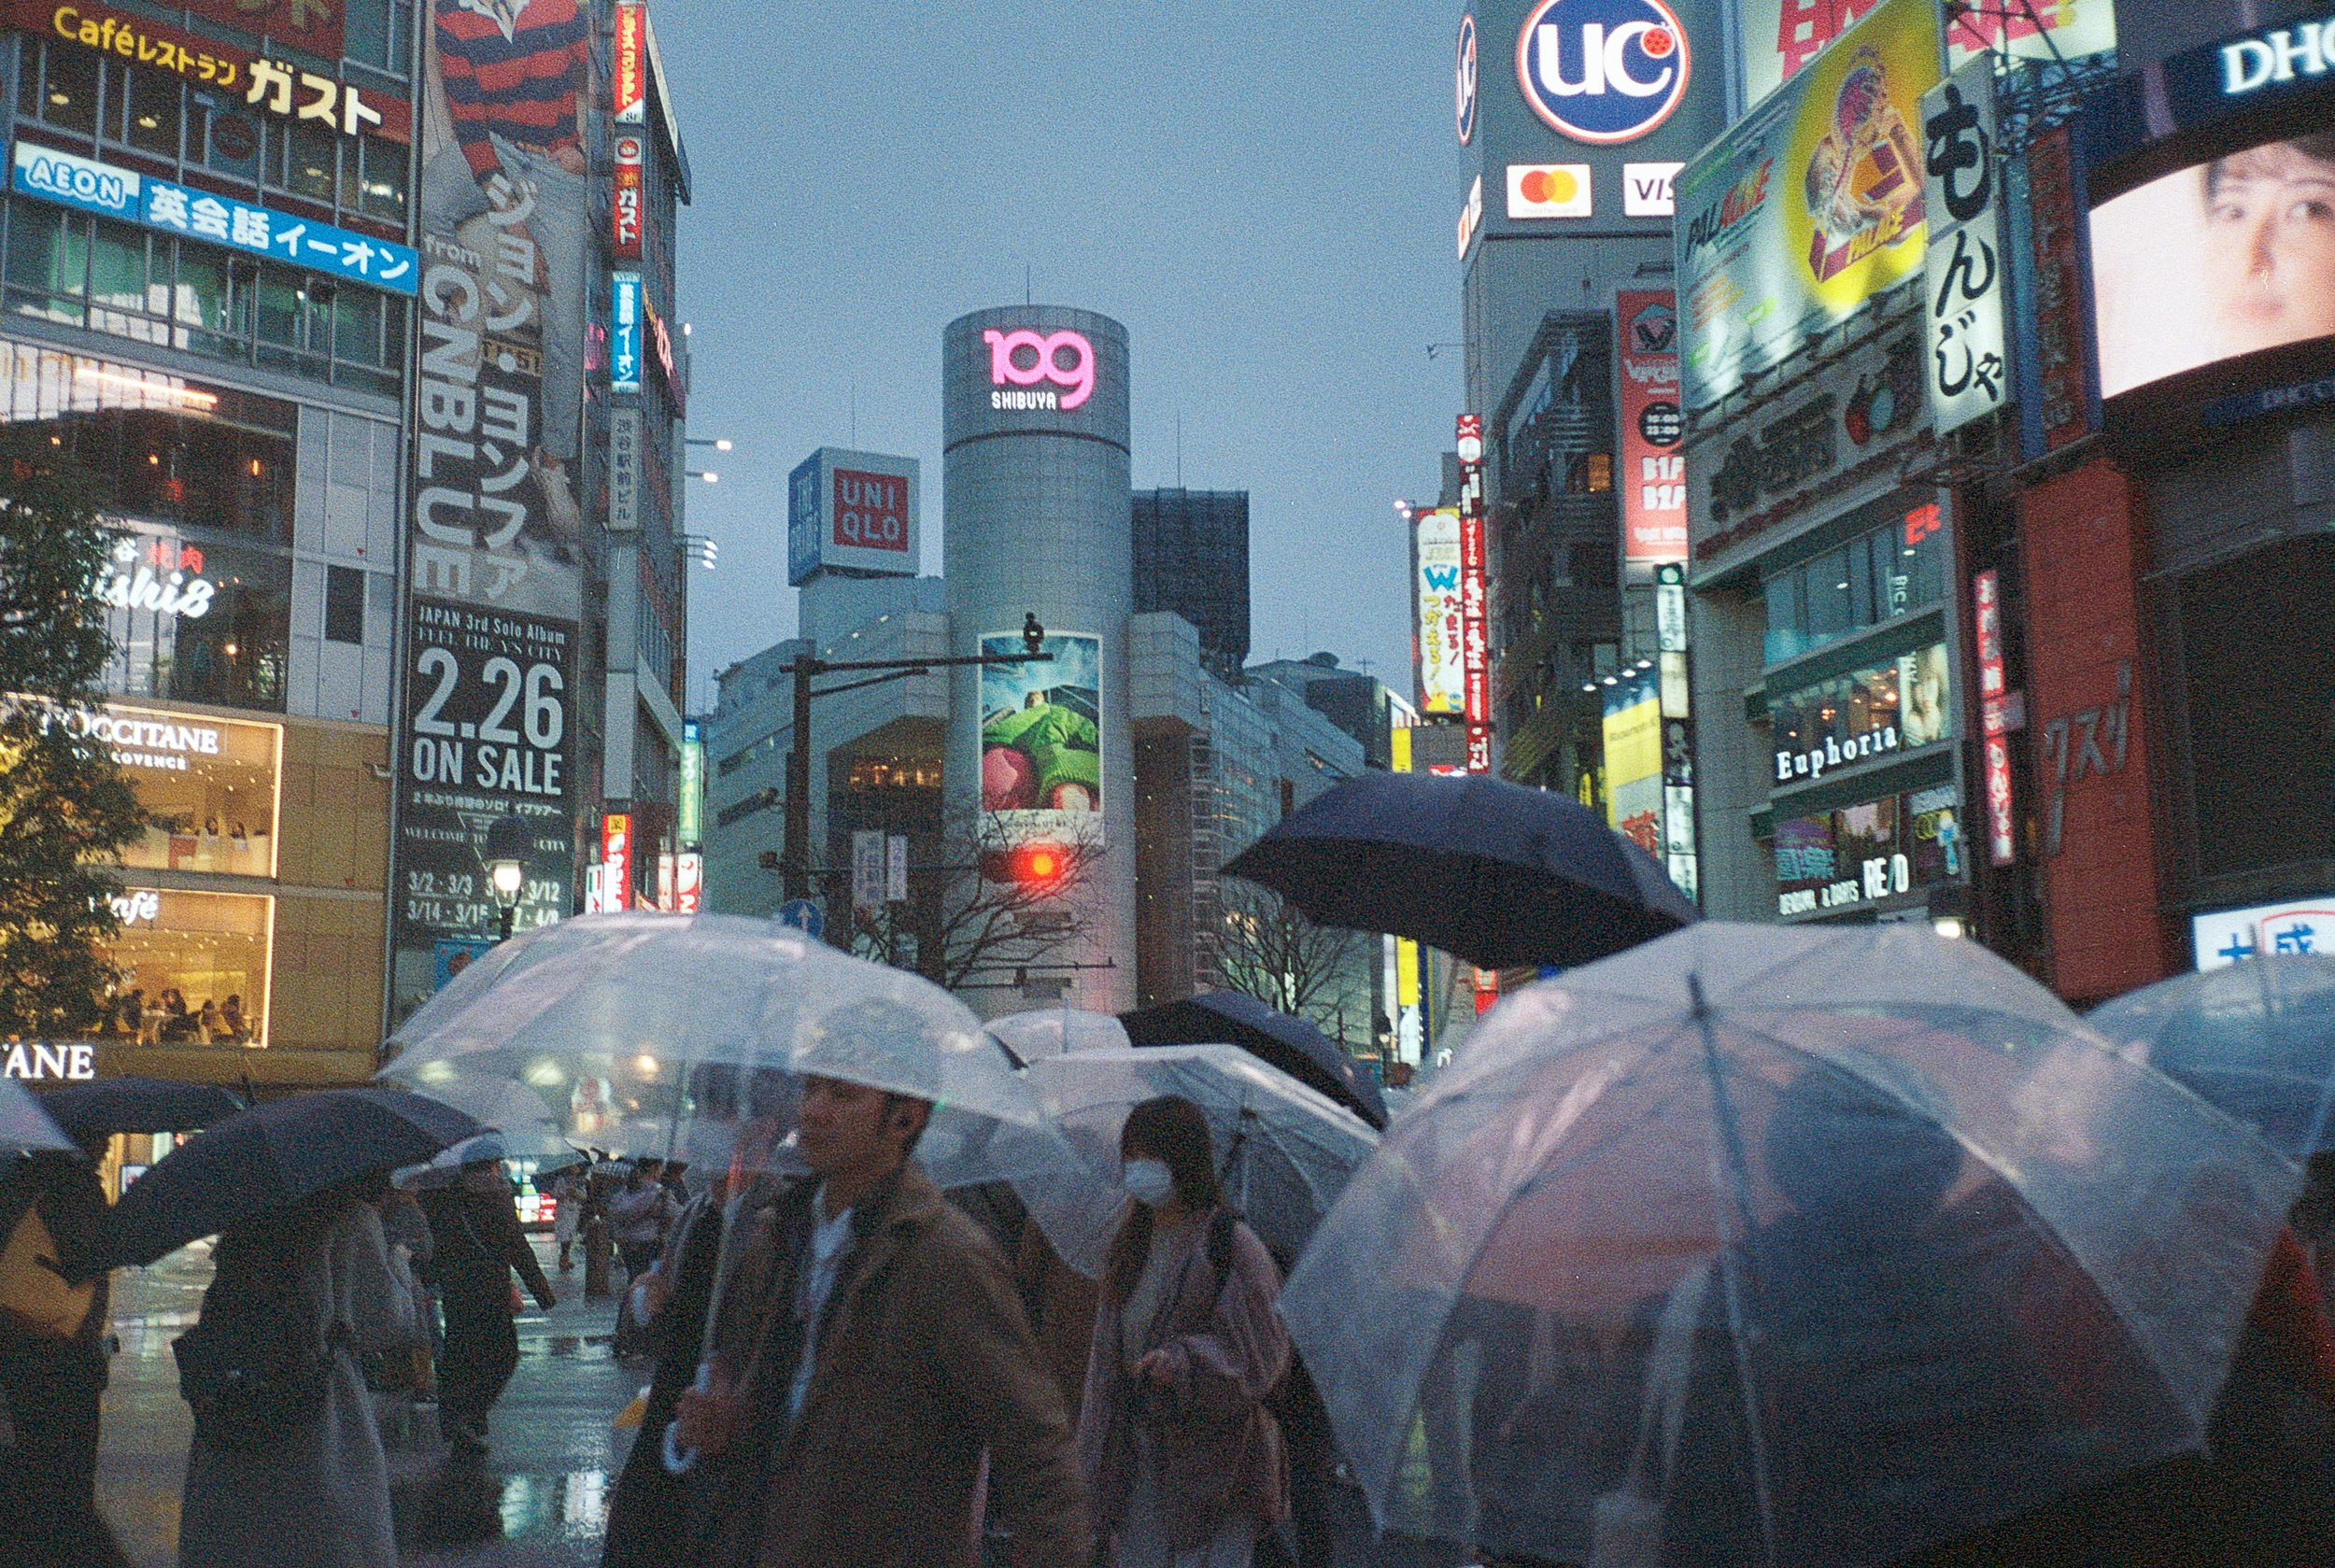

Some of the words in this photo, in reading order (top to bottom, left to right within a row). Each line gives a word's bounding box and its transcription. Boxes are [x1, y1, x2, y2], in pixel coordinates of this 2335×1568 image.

[247, 58, 381, 135] ガスト
[27, 156, 126, 209] AEON
[1633, 177, 1673, 201] VI
[618, 189, 638, 246] ガスト
[1926, 84, 2002, 402] もんじゃ
[984, 329, 1095, 411] 109
[991, 390, 1056, 410] SHIBUYA
[412, 265, 483, 595] CNBLUE
[842, 478, 894, 512] UNI
[842, 512, 900, 543] QLO
[419, 606, 460, 629] JAPAN
[493, 617, 522, 639] Solo
[415, 646, 564, 749] 2.26
[111, 751, 187, 771] OVENCE
[413, 737, 463, 785] ON
[476, 744, 563, 796] SALE
[1776, 725, 1898, 779] Euphoria
[0, 1043, 94, 1080] ANE
